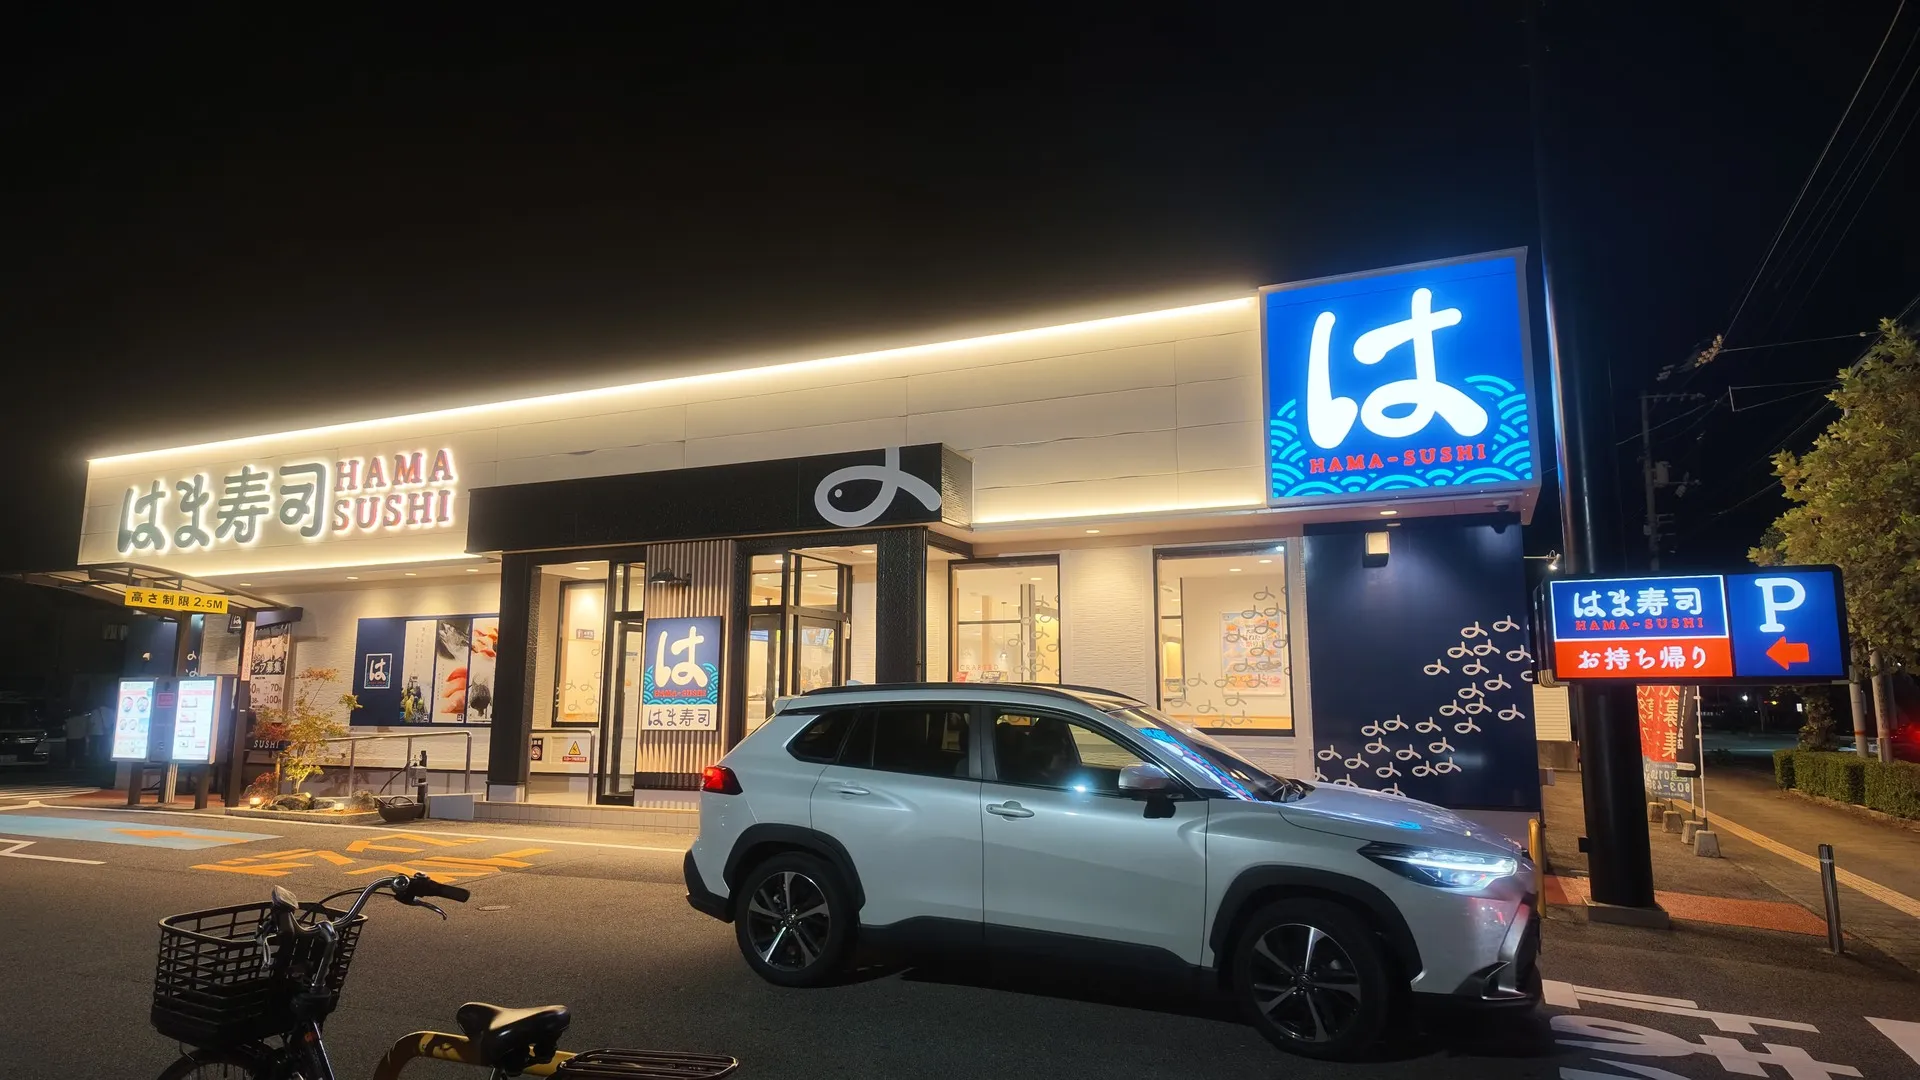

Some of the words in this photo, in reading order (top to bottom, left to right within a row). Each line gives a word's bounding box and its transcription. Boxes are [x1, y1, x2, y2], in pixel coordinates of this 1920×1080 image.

[1306, 287, 1489, 449] は
[333, 449, 454, 492] HAMA
[1309, 444, 1487, 474] HAMA-SUSHI
[116, 461, 328, 554] はま寿司
[331, 489, 450, 531] SUSHI
[1573, 587, 1703, 619] はま寿司
[1755, 577, 1806, 633] P
[1575, 617, 1704, 631] HAMA-SUSHI
[369, 658, 387, 681] は
[655, 625, 709, 688] は
[1578, 645, 1707, 671] お持ち帰り
[648, 708, 711, 727] はま寿司
[254, 739, 280, 749] SUSHI
